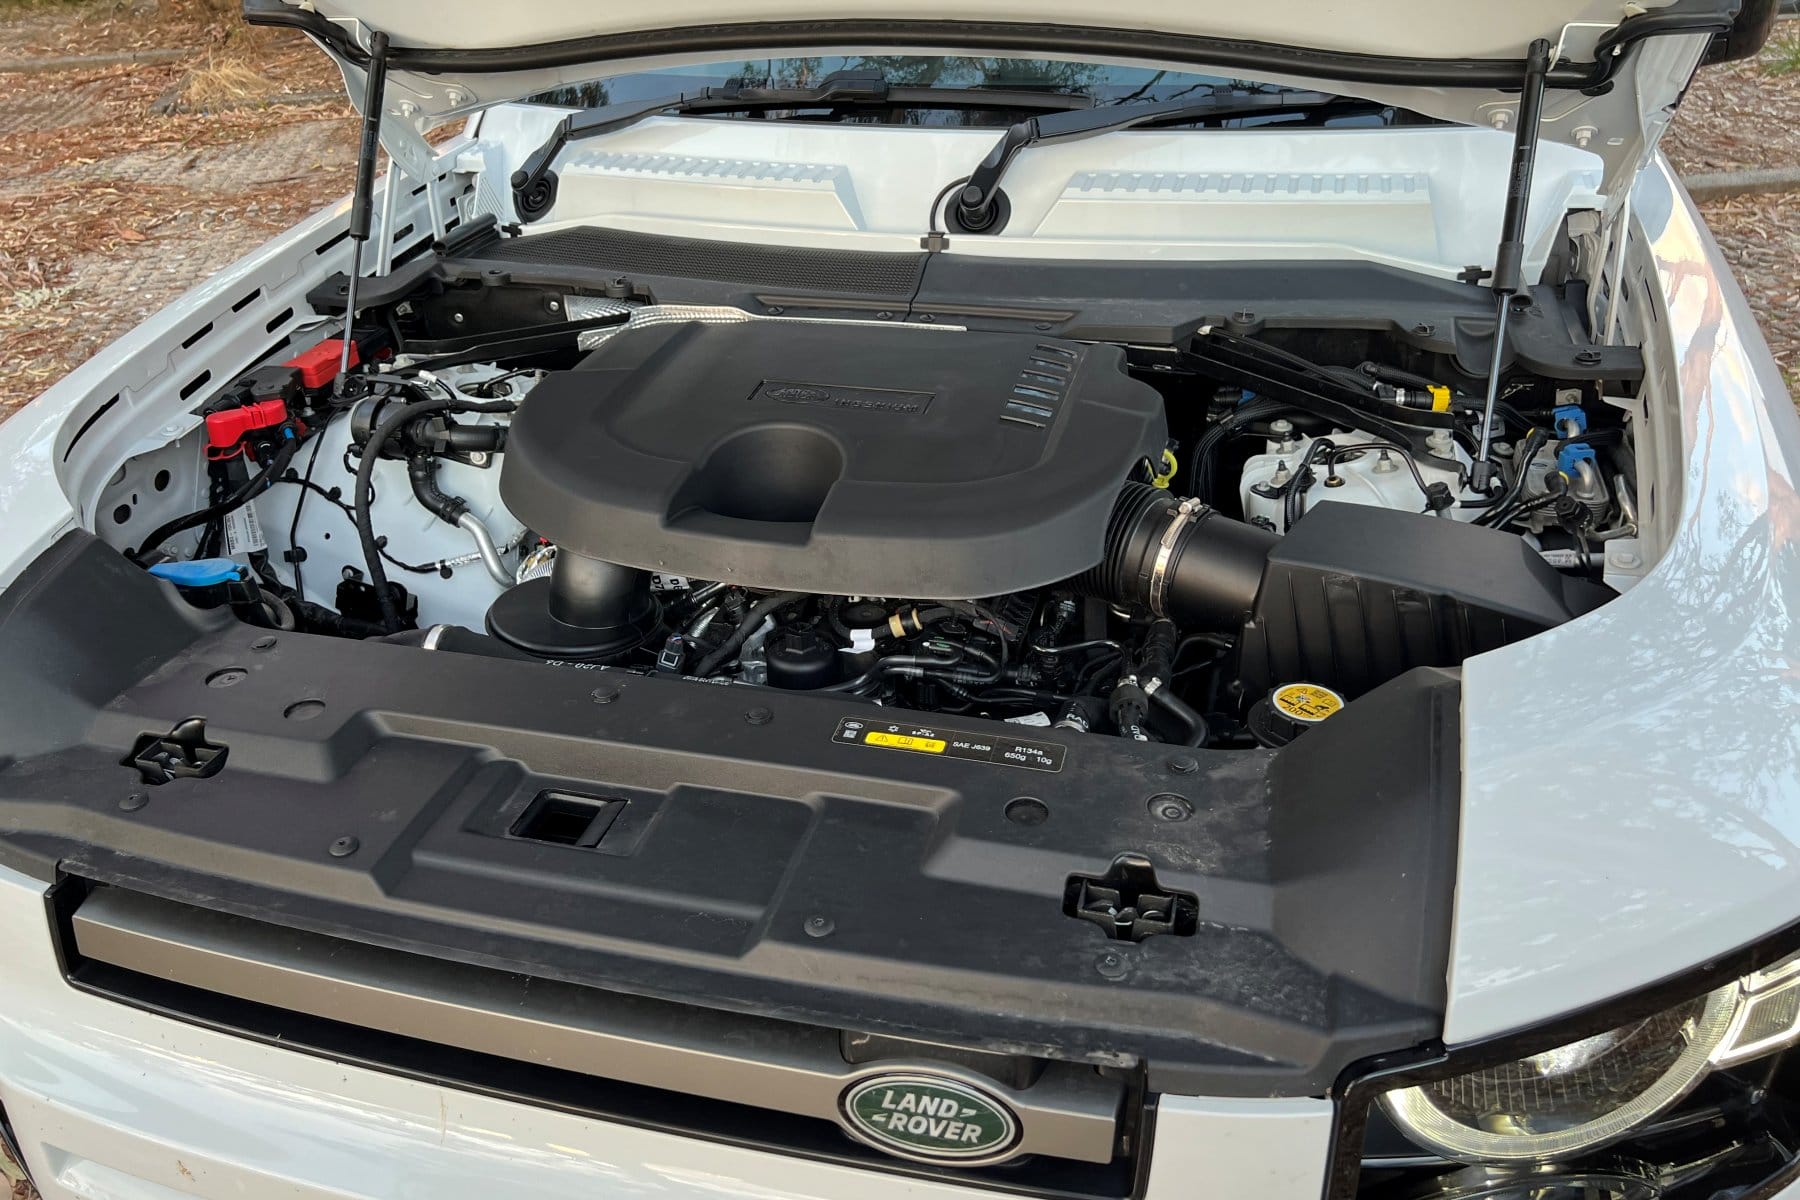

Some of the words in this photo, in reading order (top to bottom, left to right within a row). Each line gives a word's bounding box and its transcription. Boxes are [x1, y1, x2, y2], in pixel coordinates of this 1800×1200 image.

[952, 741, 970, 749] SAE
[970, 743, 991, 752] J639
[1014, 746, 1043, 756] R134a
[1004, 751, 1027, 762] 650g
[1036, 756, 1053, 765] 10g
[881, 1089, 959, 1119] LAND
[887, 1111, 982, 1144] ROVER
